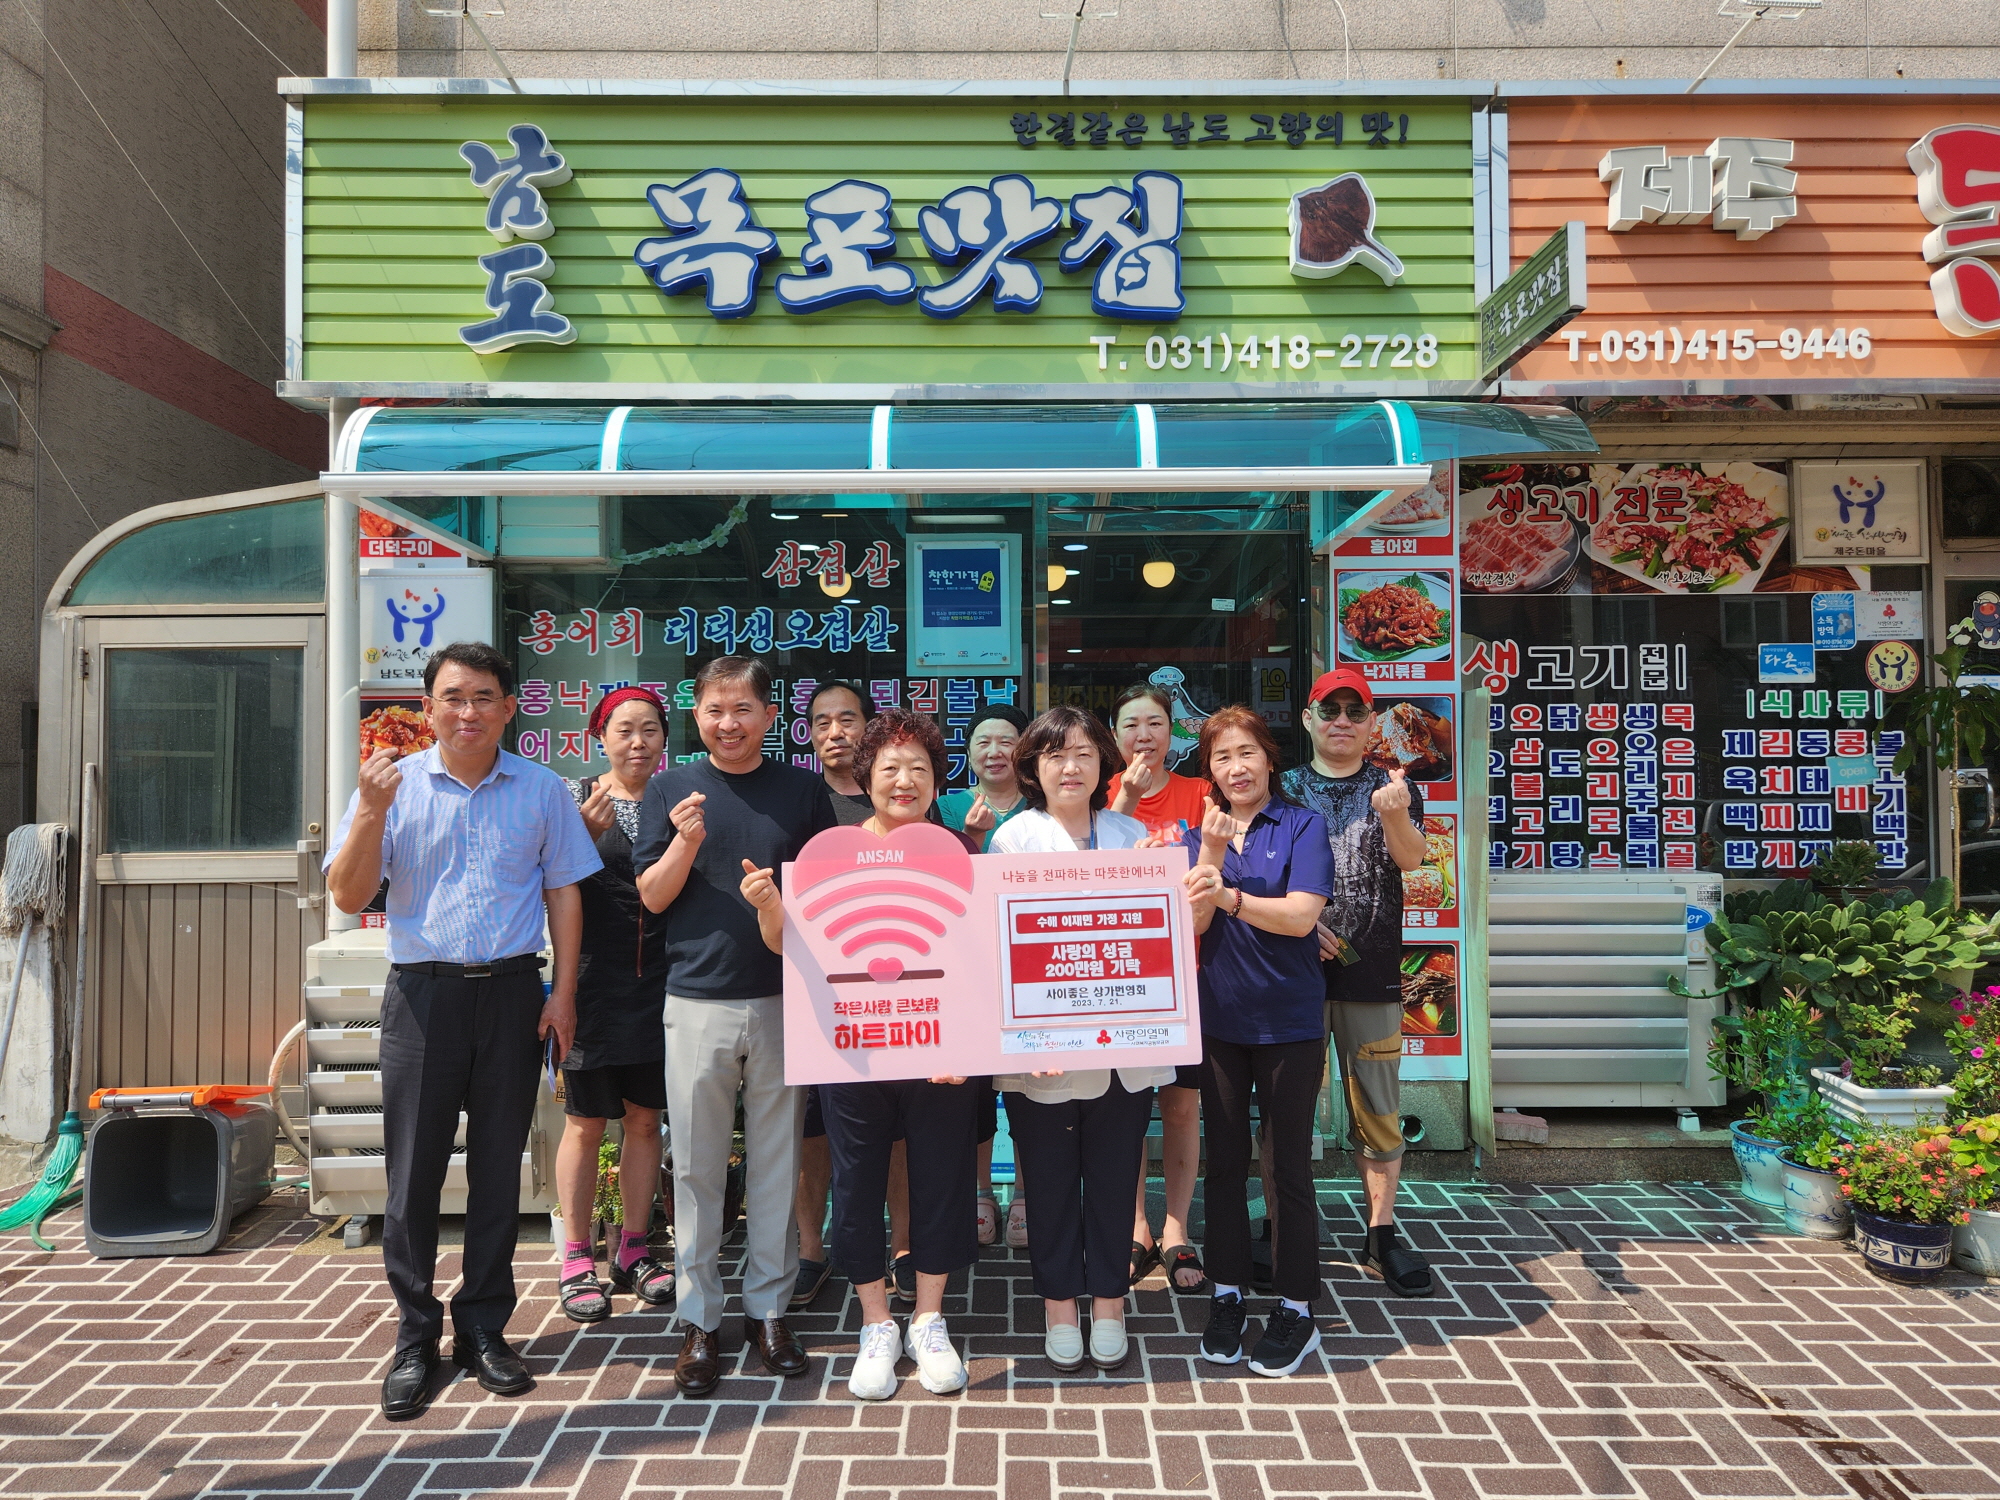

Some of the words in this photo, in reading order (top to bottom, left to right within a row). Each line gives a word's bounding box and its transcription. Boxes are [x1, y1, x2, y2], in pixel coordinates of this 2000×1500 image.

[1010, 111, 1148, 146] 한결같은
[1163, 111, 1230, 146] 남도
[1244, 111, 1344, 146] 고향의
[1362, 111, 1409, 146] 맛!
[1598, 136, 1798, 241] 제주
[459, 123, 579, 354] 남도
[634, 168, 1186, 321] 목포맛집
[1090, 335, 1127, 370] T.
[1144, 332, 1439, 373] 031)418-2728
[1485, 481, 1601, 526] 생고기
[1611, 481, 1693, 526] 전문
[368, 540, 433, 556] 더덕구이
[1370, 538, 1417, 554] 홍어회
[1834, 546, 1887, 556] 제주돈마을
[762, 539, 900, 588] 삼겹살
[928, 569, 979, 585] 착한가격
[1467, 572, 1517, 587] 생삼겹살
[518, 607, 644, 657] 홍어회
[663, 605, 900, 656] 더덕생오겹살
[1817, 616, 1834, 625] 소독
[1817, 626, 1834, 636] 방역
[1363, 664, 1427, 679] 낙지볶음
[1461, 639, 1628, 696] 생고기
[1640, 643, 1668, 690] 전문
[1764, 652, 1797, 668] 다온
[1760, 690, 1869, 719] 식사류
[1839, 766, 1868, 778] open
[1510, 704, 1544, 869] 오삼불고기
[1547, 704, 1584, 869] 닭도리탕
[1585, 704, 1621, 869] 생오리로스
[1623, 704, 1659, 869] 생오리주물럭
[1662, 704, 1697, 869] 묵은지전골
[1722, 729, 1758, 868] 제육백반
[1759, 729, 1796, 868] 김치찌개
[857, 850, 904, 865] ANSAN
[1002, 869, 1039, 883] 나눔을
[1043, 867, 1091, 882] 전파하는
[1095, 864, 1167, 881] 따뜻한에너지
[1037, 916, 1058, 928] 수해
[1061, 914, 1093, 927] 이재민
[1097, 913, 1118, 926] 가정
[1121, 912, 1143, 924] 지원
[1051, 942, 1096, 961] 사랑의
[1102, 941, 1133, 959] 성금
[1045, 960, 1105, 978] 200만원
[1110, 958, 1141, 976] 기탁
[1046, 986, 1089, 1000] 사이좋은
[1093, 984, 1146, 998] 상가번영회
[834, 999, 892, 1016] 작은사랑
[896, 996, 940, 1013] 큰보람
[834, 1019, 940, 1049] 하트파이
[1114, 1027, 1169, 1041] 사랑의열매
